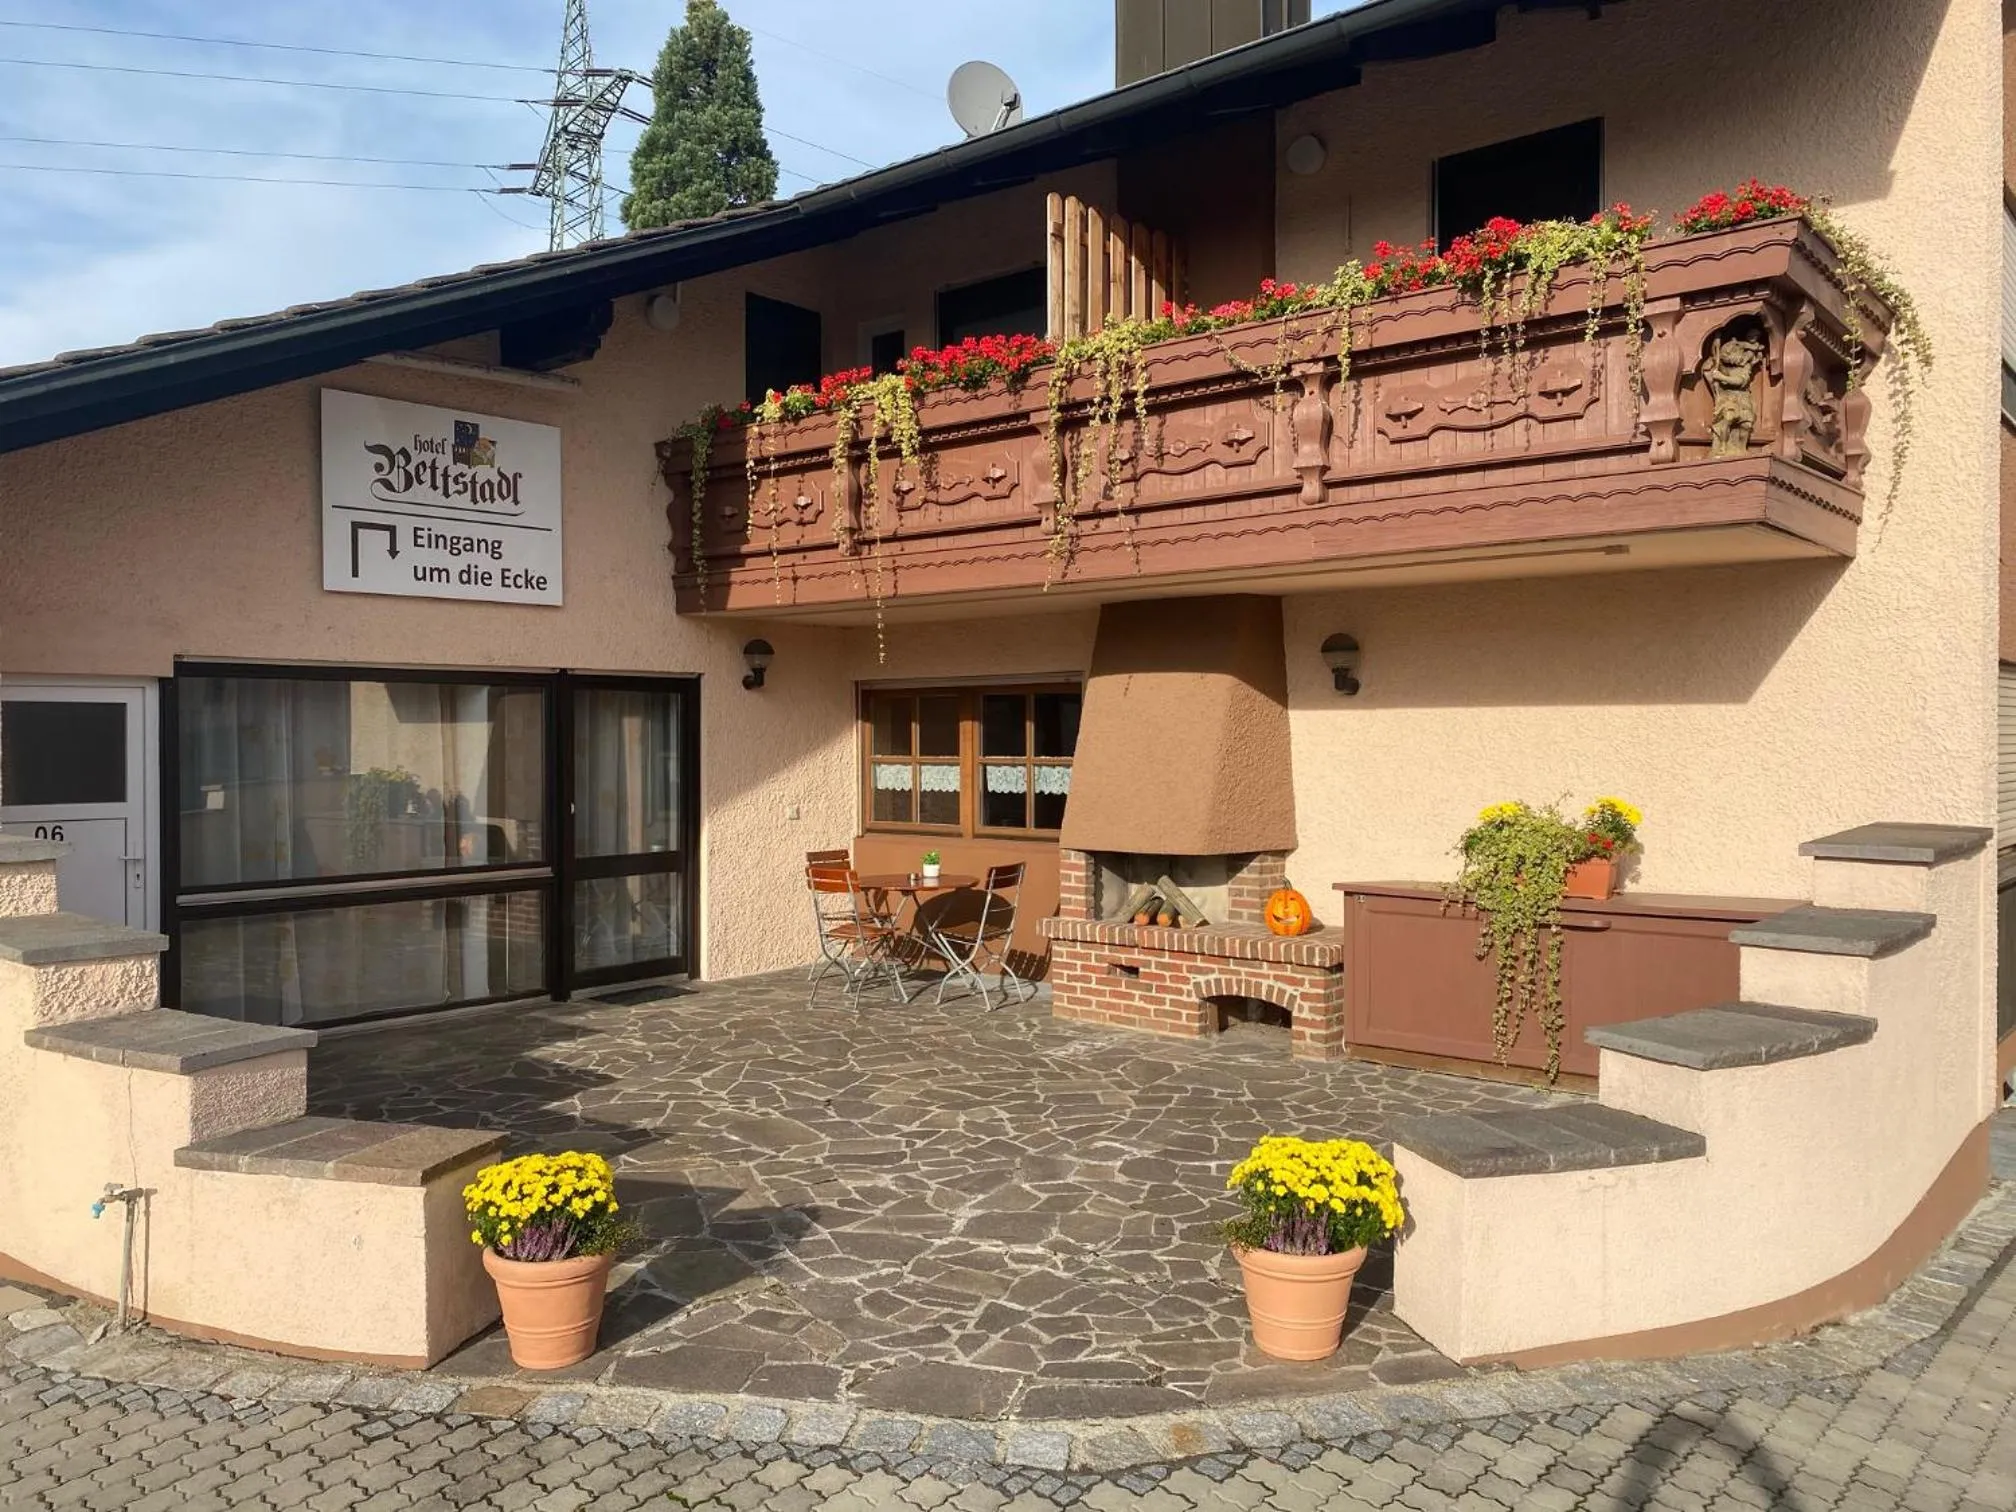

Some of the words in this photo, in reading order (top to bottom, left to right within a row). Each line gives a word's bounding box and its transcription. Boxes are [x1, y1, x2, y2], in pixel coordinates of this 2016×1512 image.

[413, 434, 448, 455] hotel
[363, 440, 522, 506] Bettstadl
[413, 527, 503, 560] Eingang
[413, 565, 450, 584] um
[458, 564, 492, 587] die
[501, 568, 548, 591] Ecke
